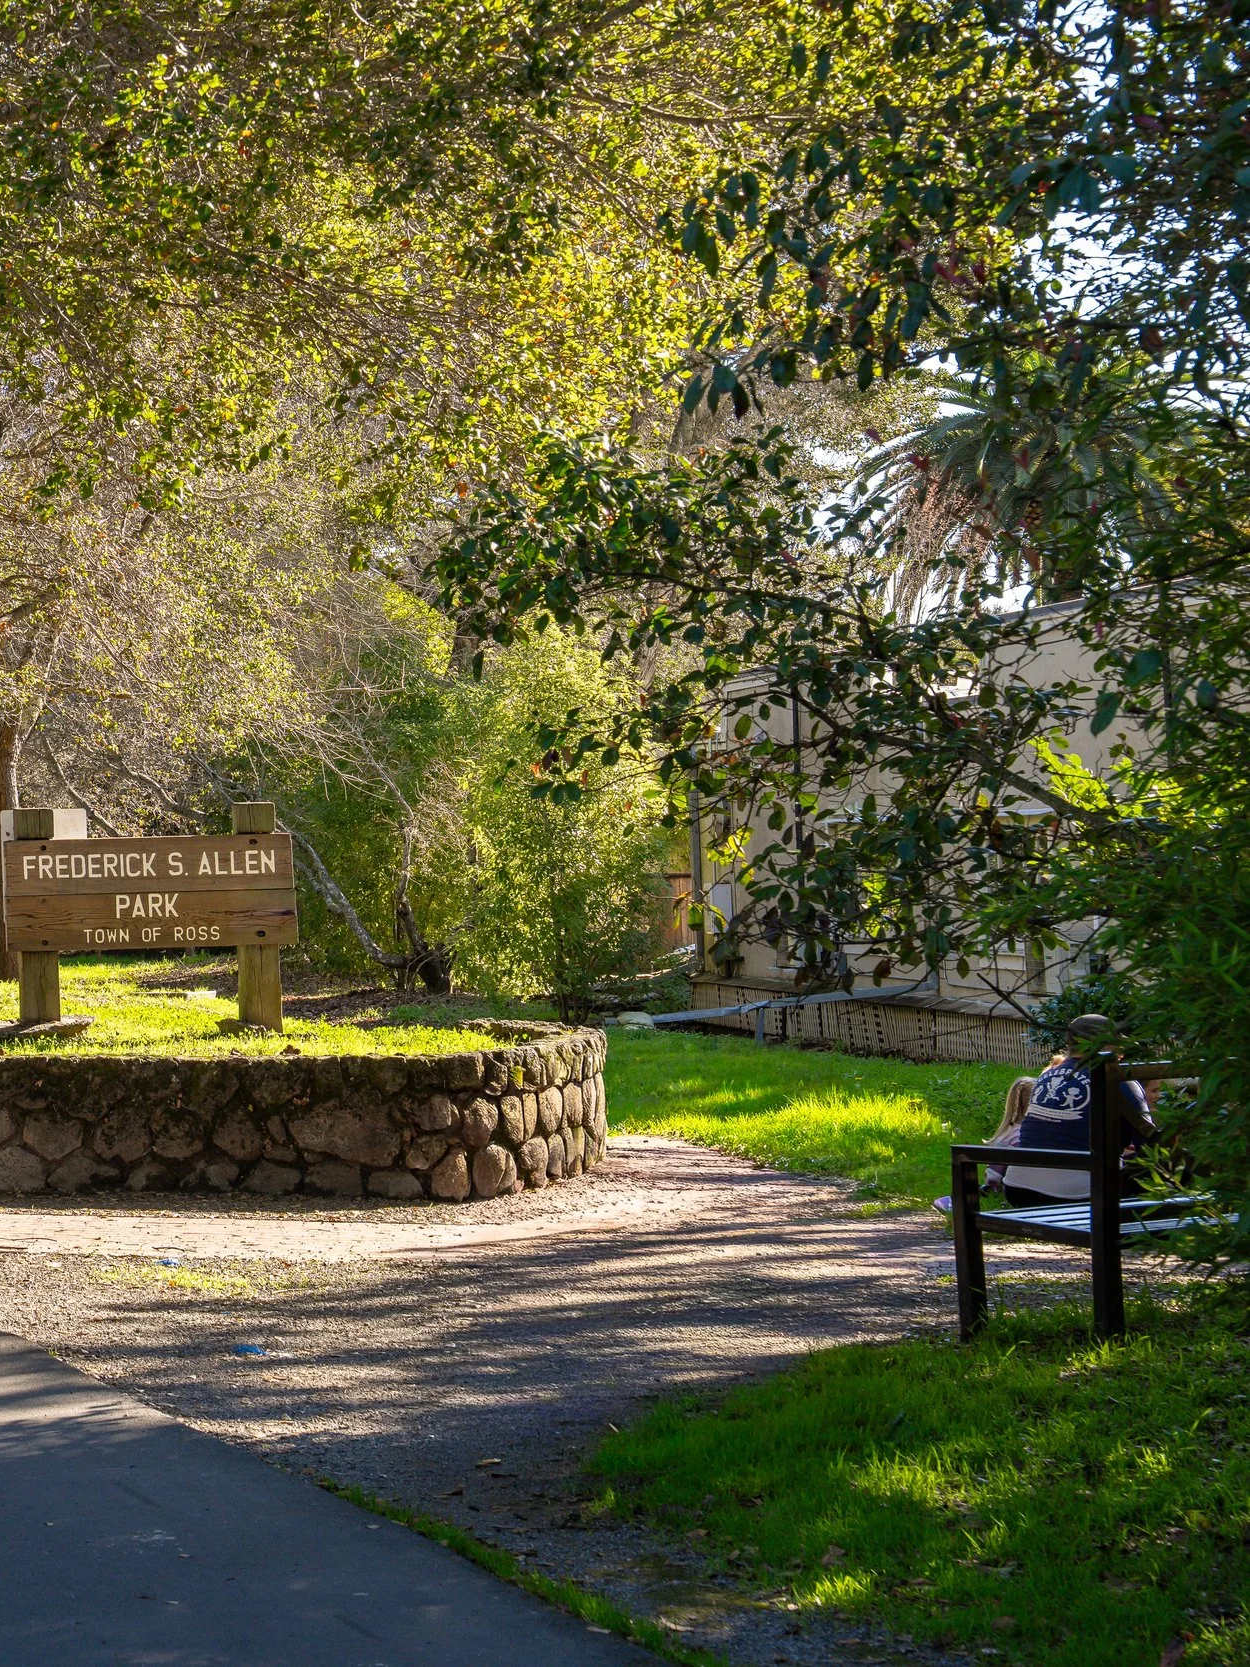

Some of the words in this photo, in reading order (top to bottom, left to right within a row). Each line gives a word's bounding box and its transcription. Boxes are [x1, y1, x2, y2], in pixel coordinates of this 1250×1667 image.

[22, 853, 157, 880] FREDERICK
[168, 852, 188, 877] S.
[198, 850, 276, 875] ALLEN
[115, 893, 179, 918] PARK
[84, 928, 129, 944] TOWN
[141, 927, 161, 942] OF
[174, 925, 220, 941] ROSS
